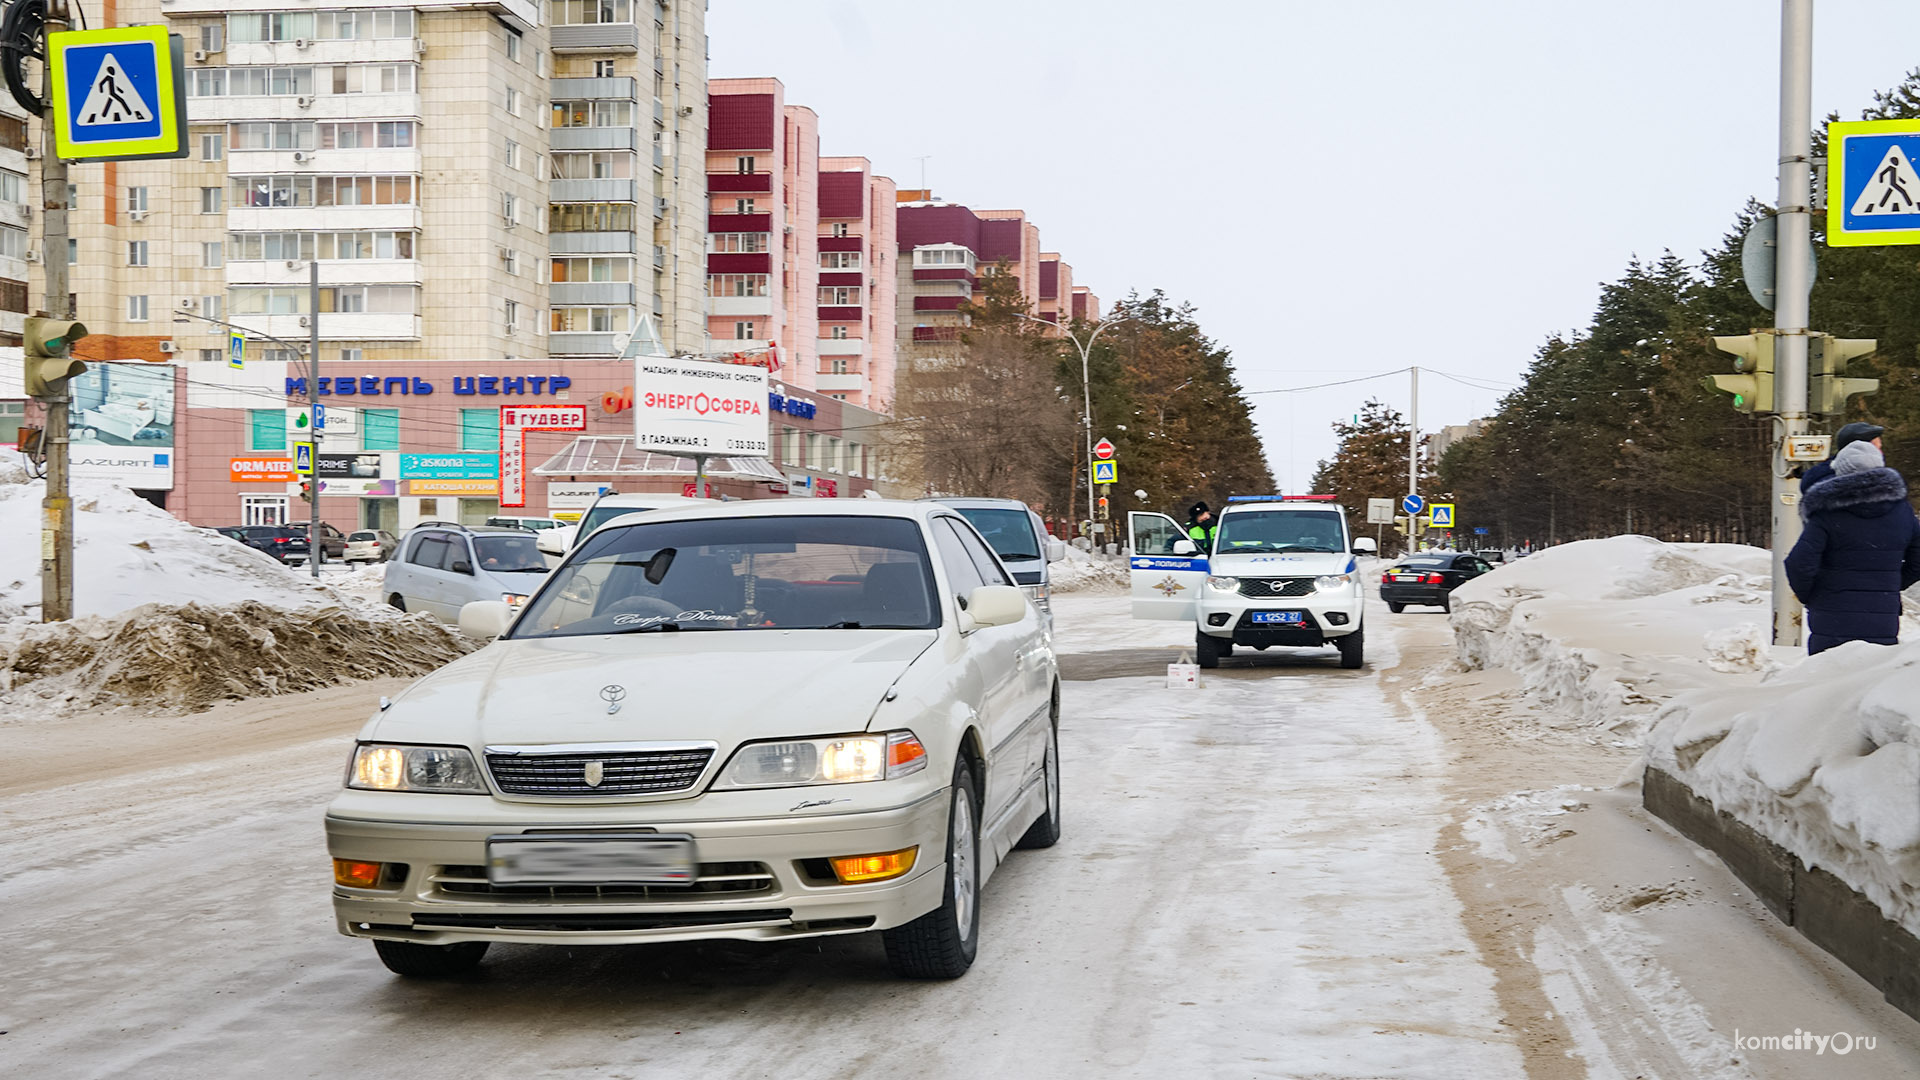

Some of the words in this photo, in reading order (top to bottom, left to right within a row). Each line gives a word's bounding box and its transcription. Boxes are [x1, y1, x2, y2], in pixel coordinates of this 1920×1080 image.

[643, 365, 678, 376] МАГАЗИН
[681, 368, 732, 380] ИНЖЕНЕРНЫХ
[734, 373, 763, 383] СИСТЕМ
[285, 376, 433, 396] МЕБЕЛЬ
[453, 376, 571, 396] ЦЕНТР
[644, 391, 761, 415] ЭНЕРГОСФЕРА
[521, 413, 580, 425] ГУДВЕР
[703, 438, 708, 447] 2
[735, 439, 766, 451] 32-32-32
[68, 458, 152, 467] LAZURIT
[318, 460, 348, 469] PRIME
[420, 457, 464, 468] askona
[1154, 560, 1192, 568] ПОЛИЦИЯ
[613, 613, 671, 627] Carpe
[673, 609, 739, 622] Diem
